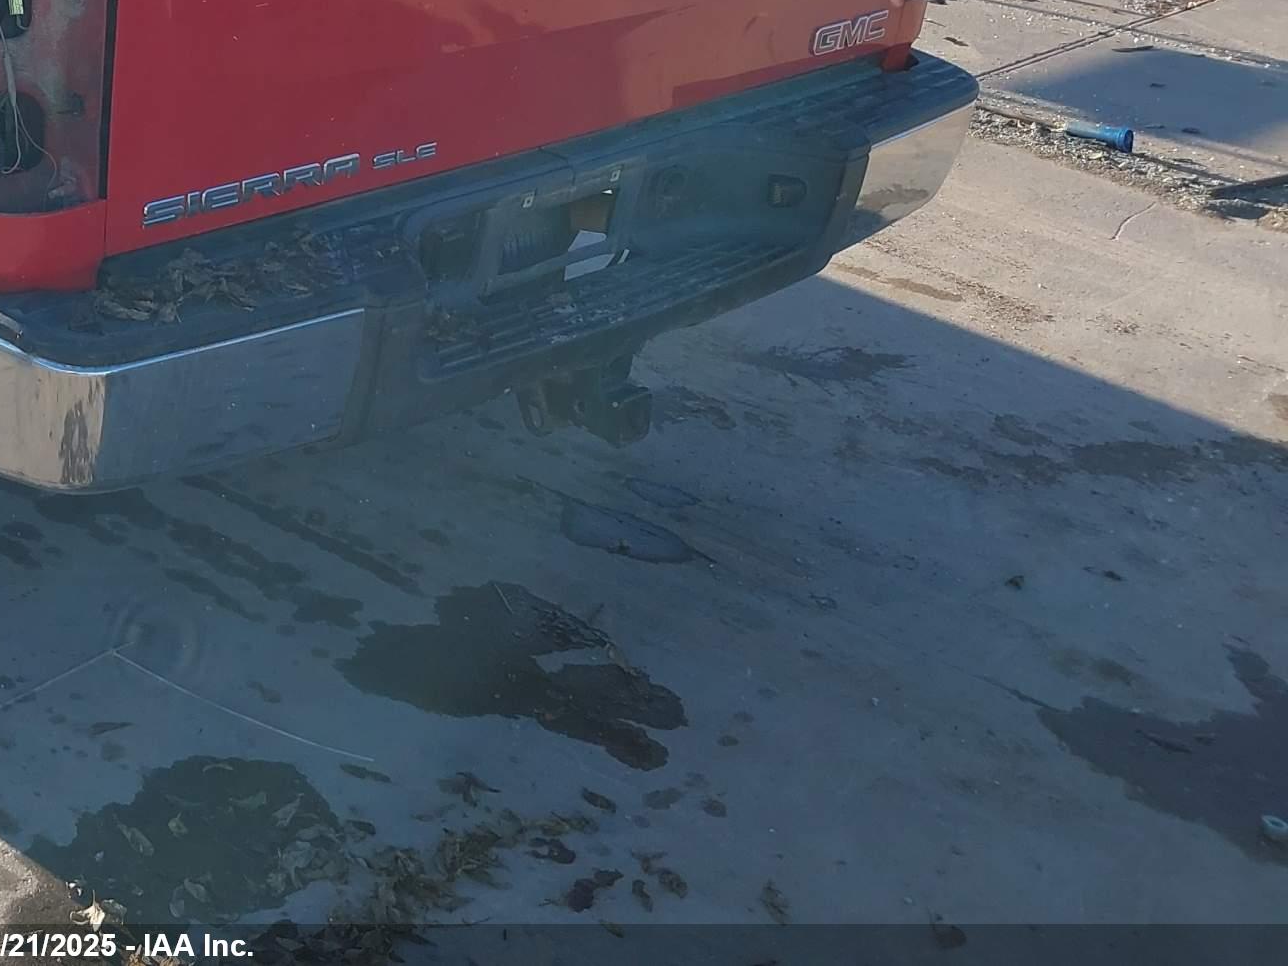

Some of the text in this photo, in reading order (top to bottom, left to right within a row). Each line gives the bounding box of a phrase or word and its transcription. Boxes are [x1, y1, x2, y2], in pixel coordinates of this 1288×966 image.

[813, 10, 889, 55] GMC
[142, 142, 438, 229] SIERRA SLE
